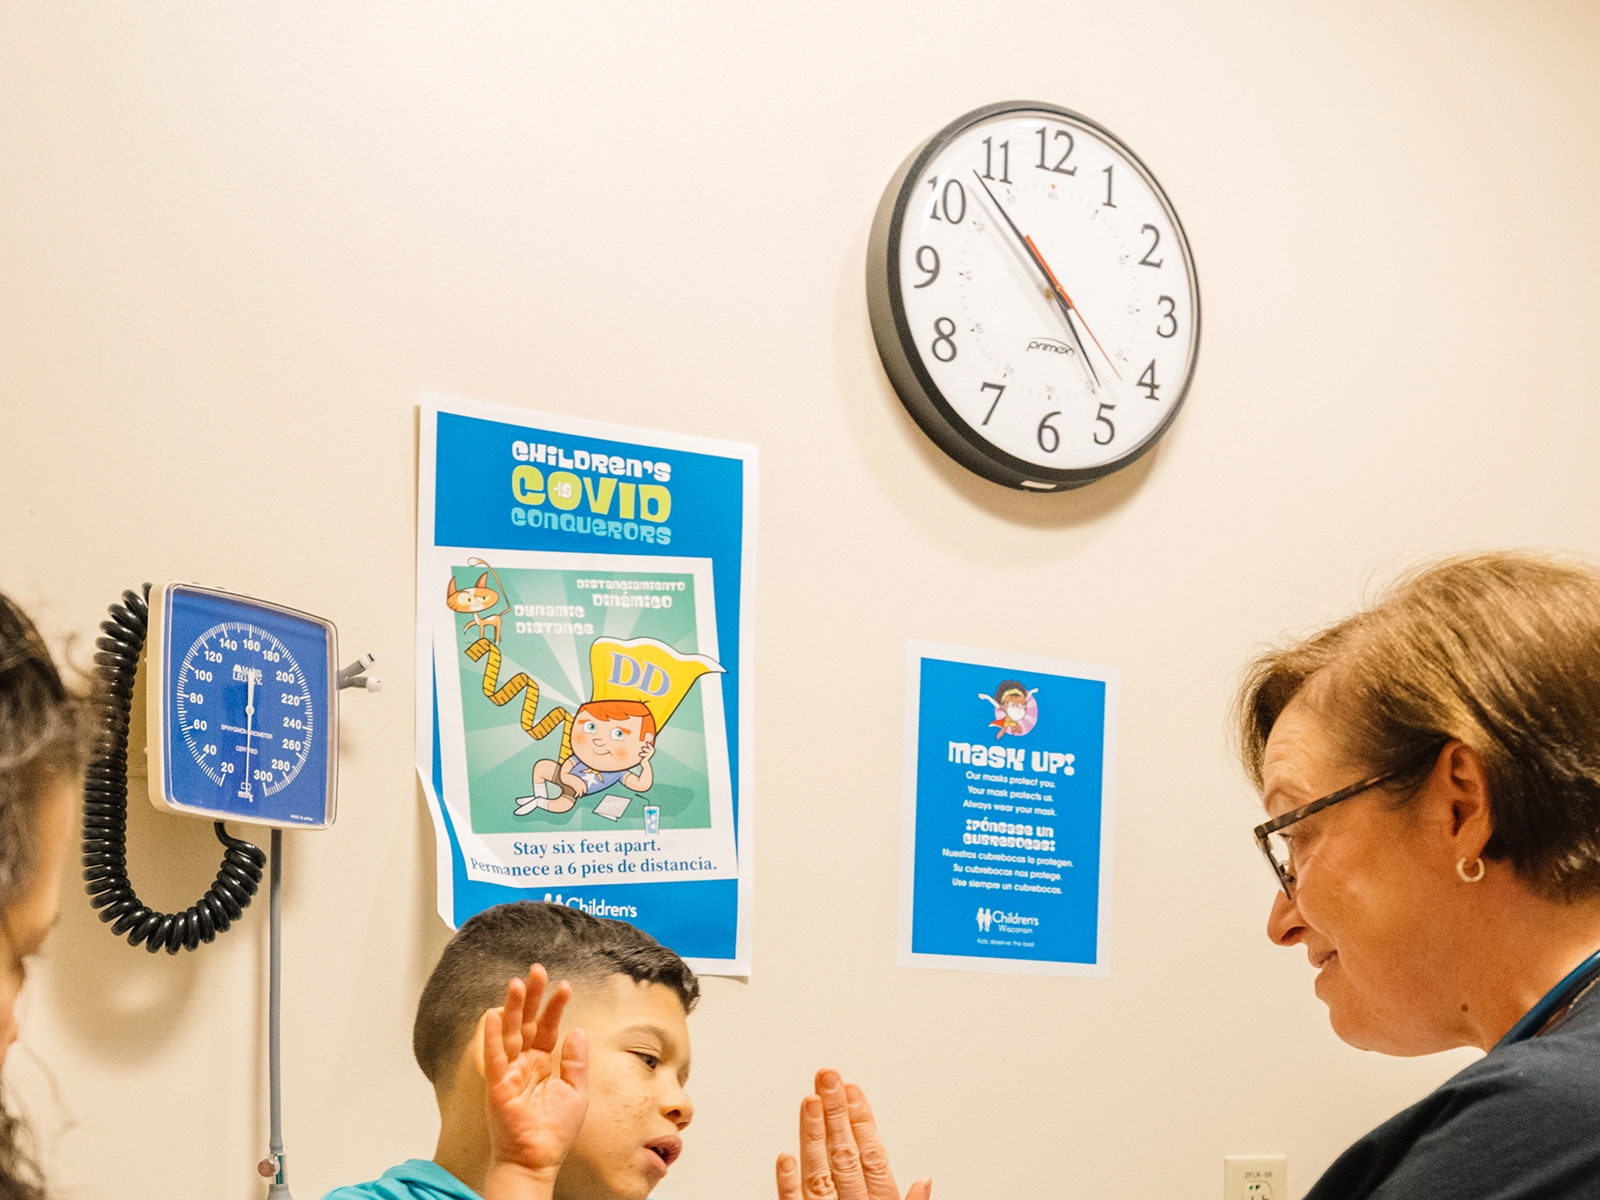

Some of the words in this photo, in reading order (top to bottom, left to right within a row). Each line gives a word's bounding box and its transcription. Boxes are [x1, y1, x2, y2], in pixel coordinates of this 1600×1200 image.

[1035, 126, 1077, 177] 12
[981, 136, 1013, 185] 11
[1102, 164, 1118, 209] 1
[927, 175, 966, 225] 10
[1139, 223, 1164, 269] 2
[914, 245, 941, 289] 9
[1156, 295, 1178, 338] 3
[931, 316, 957, 363] 8
[1136, 358, 1160, 401] 4
[980, 381, 1007, 427] 7
[1093, 403, 1116, 445] 5
[1037, 411, 1062, 453] 6
[512, 465, 672, 523] COVID
[511, 507, 672, 545] CONQUERORS
[577, 579, 686, 592] DISTANCIAMIENTO
[592, 591, 673, 609] DINÁMICO
[514, 605, 586, 618] DYNAMIC
[515, 622, 595, 635] DISTANCE
[220, 638, 237, 651] 140
[243, 639, 260, 652] 160
[205, 651, 223, 663] 120
[263, 650, 279, 663] 180
[195, 670, 213, 682] 100
[276, 671, 295, 684] 200
[608, 653, 671, 697] DD
[190, 694, 204, 705] 80
[281, 693, 300, 706] 220
[194, 720, 207, 731] 60
[283, 717, 302, 730] 240
[203, 744, 217, 755] 40
[283, 738, 301, 751] 260
[271, 759, 290, 772] 280
[948, 741, 1026, 772] MASK
[1031, 751, 1076, 776] UP!
[221, 762, 234, 774] 20
[254, 770, 273, 782] 300
[966, 771, 981, 780] Our
[983, 773, 1008, 783] masks
[1010, 776, 1038, 786] protect
[1040, 780, 1056, 789] you.
[967, 786, 985, 795] Your
[987, 788, 1008, 798] mask
[1010, 790, 1042, 801] protects
[963, 800, 992, 811] Always
[994, 803, 1014, 812] wear
[1015, 806, 1033, 814] your
[1034, 807, 1057, 817] mask.
[1036, 826, 1054, 838] UN
[513, 842, 548, 859] Stay
[553, 840, 576, 855] six
[580, 839, 610, 853] feet
[615, 839, 661, 856] apart.
[942, 848, 977, 859] Nuestros
[978, 852, 1026, 863] cubrebocas
[1028, 856, 1035, 864] lo
[470, 857, 550, 877] Permanece
[554, 865, 563, 875] a
[568, 862, 577, 875] 6
[582, 860, 614, 878] pies
[618, 859, 636, 873] de
[640, 857, 717, 872] distancia.
[953, 863, 963, 873] Su
[965, 865, 1013, 876] cubrebocas
[1015, 870, 1029, 878] nos
[952, 878, 967, 887] Use
[969, 880, 1001, 890] siempre
[993, 910, 1039, 926] Children's
[999, 924, 1033, 934] Wisconsin
